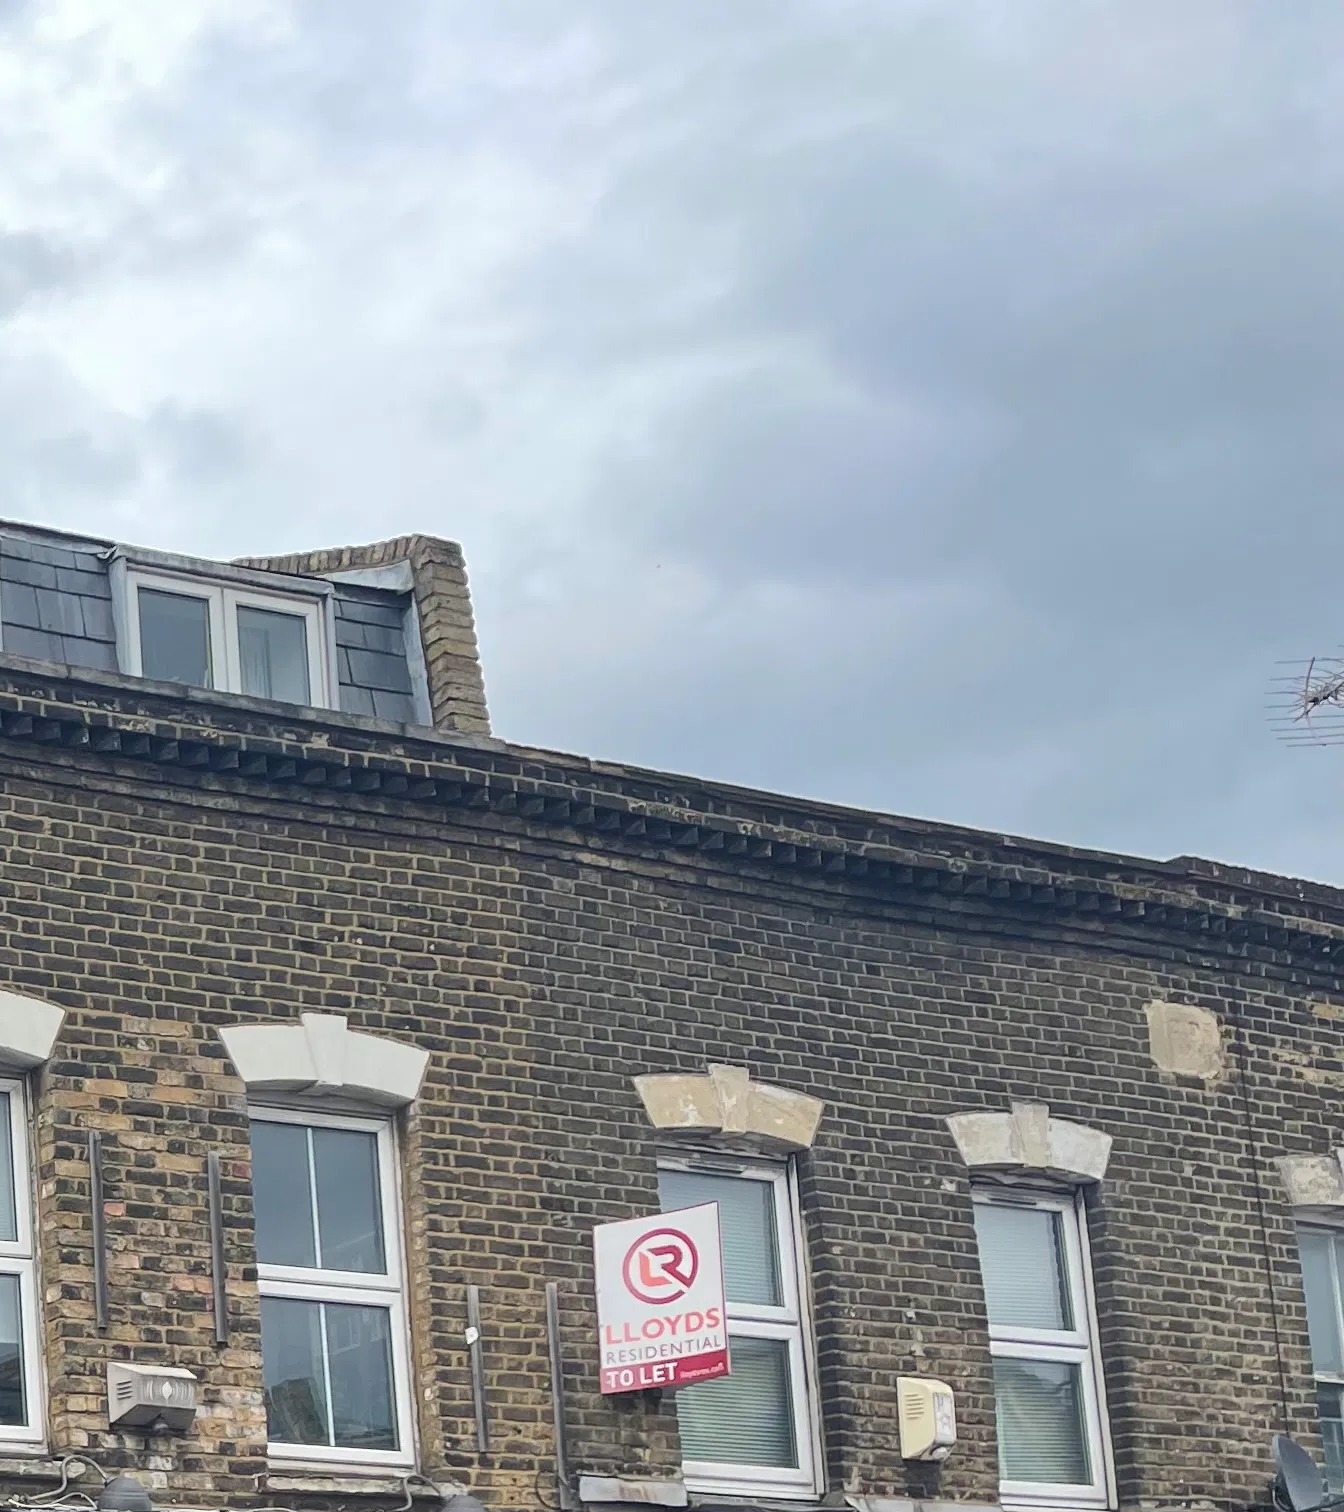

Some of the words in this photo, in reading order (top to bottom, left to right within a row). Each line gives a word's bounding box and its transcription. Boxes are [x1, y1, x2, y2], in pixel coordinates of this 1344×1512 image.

[606, 1307, 720, 1345] LLOYDS
[606, 1335, 722, 1365] RESIDENTIAL
[606, 1370, 634, 1389] TO
[639, 1362, 679, 1385] LET
